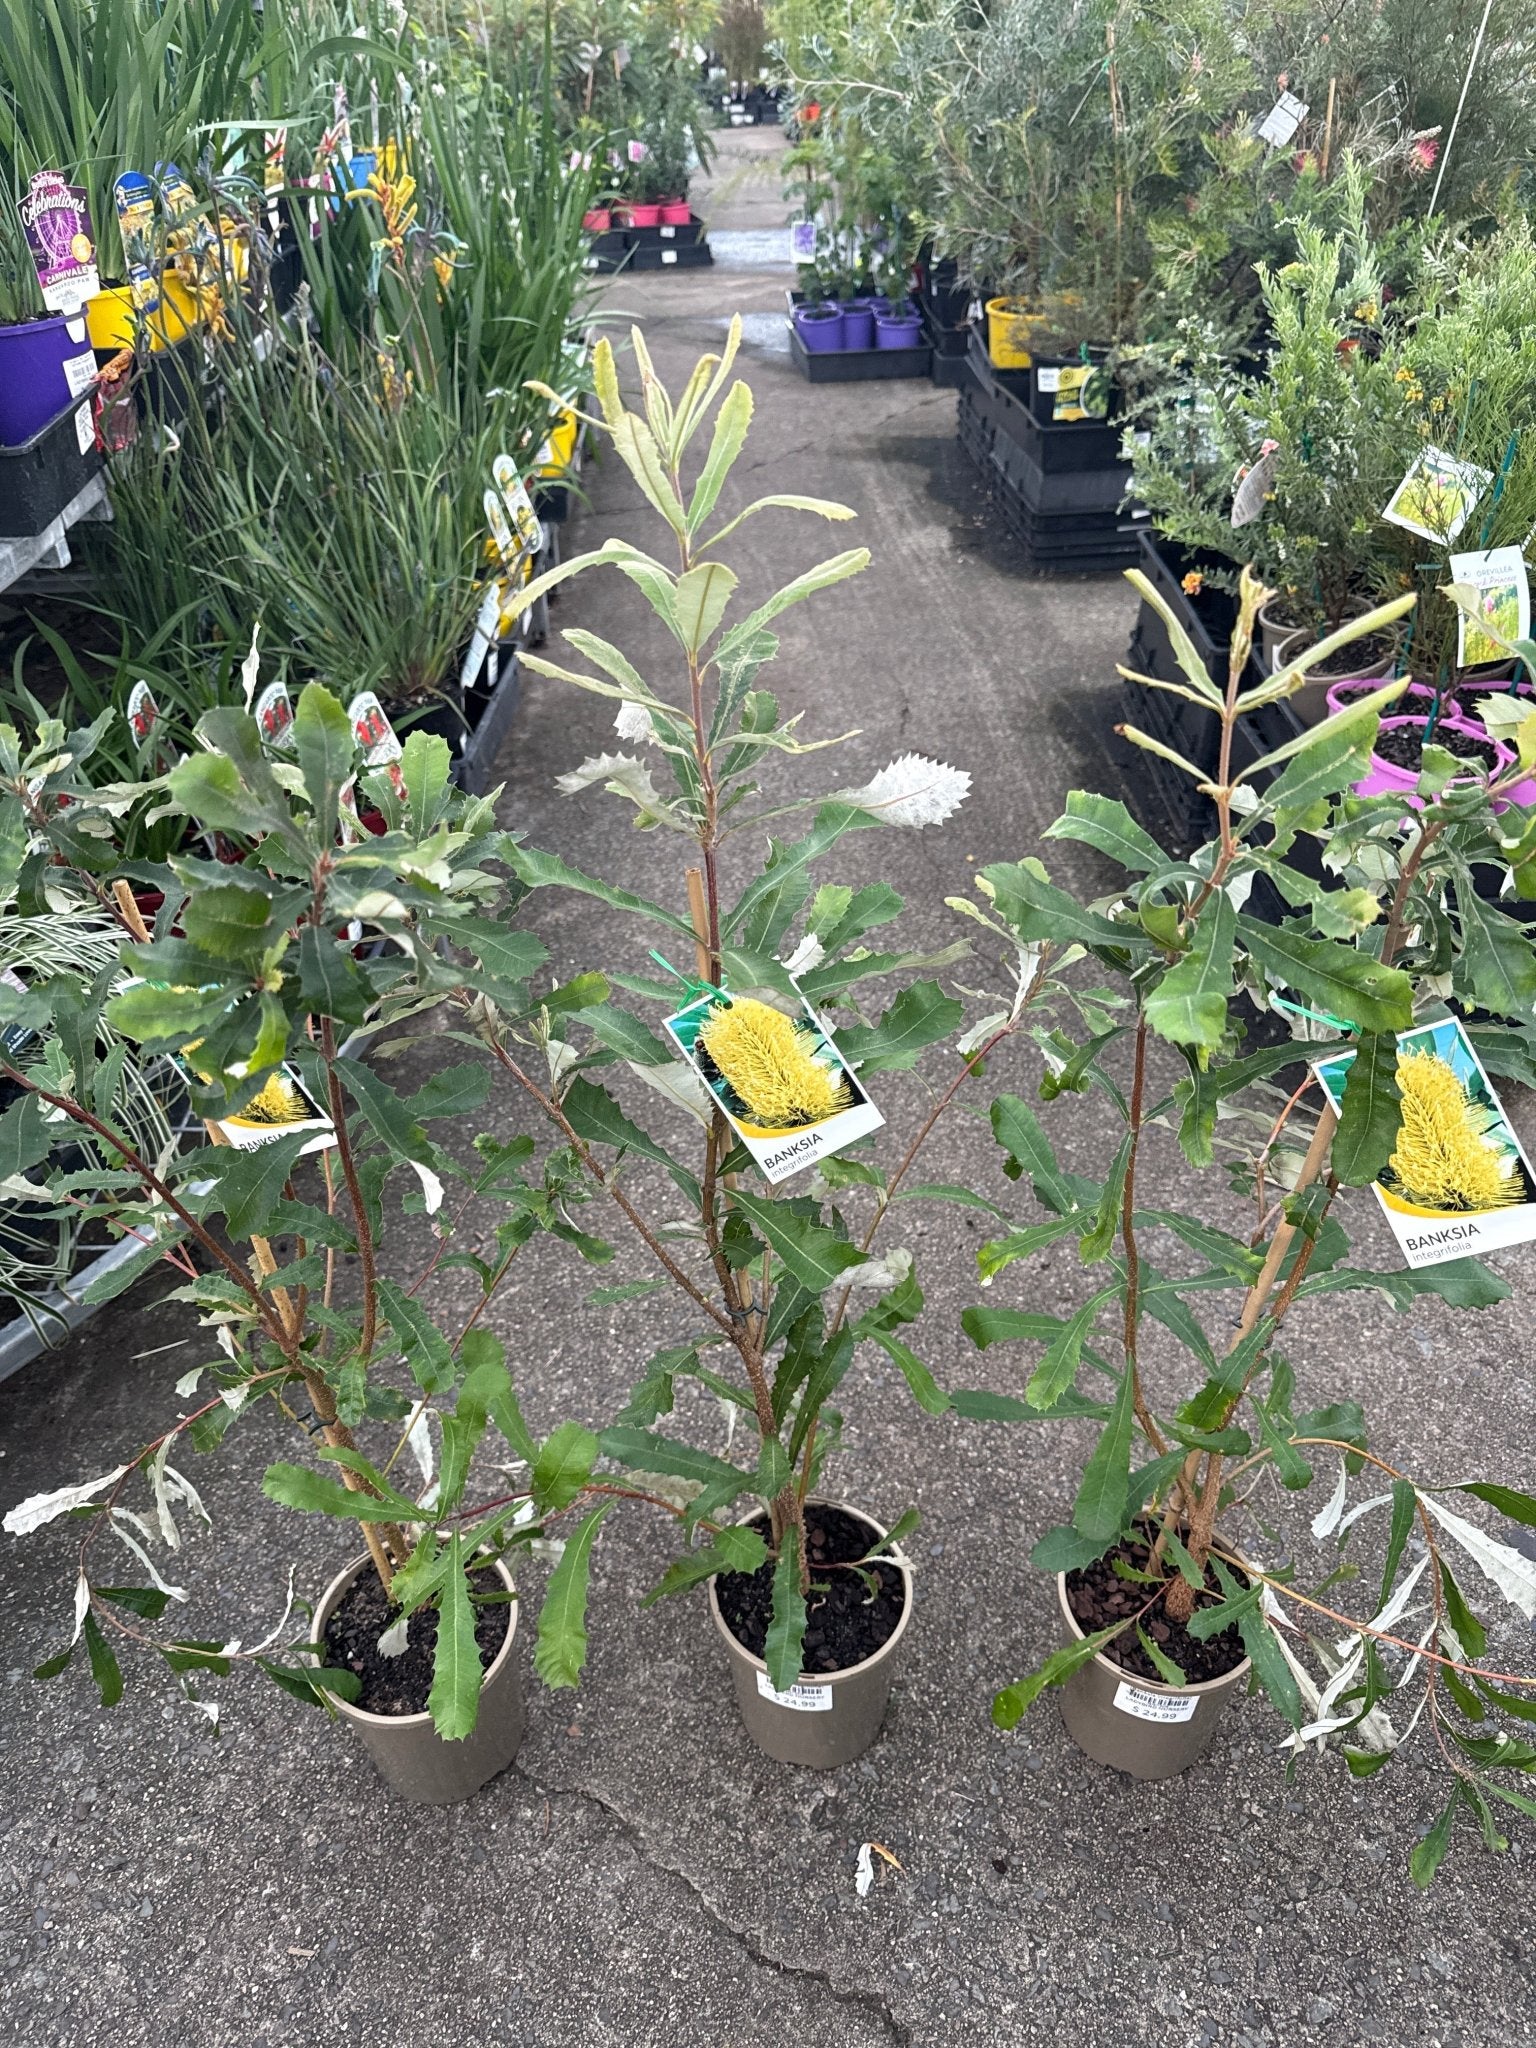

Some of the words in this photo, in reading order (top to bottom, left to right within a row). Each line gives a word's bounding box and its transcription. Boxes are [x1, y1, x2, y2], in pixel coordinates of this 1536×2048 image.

[22, 191, 86, 227] Celebrations
[47, 265, 89, 285] CARNIVALE
[764, 1133, 823, 1169] BANKSIA
[771, 1149, 818, 1177] integrifolia
[1405, 1223, 1481, 1251] BANKSIA
[1412, 1242, 1472, 1262] integrifolia
[783, 1697, 816, 1707] 24.99
[1142, 1709, 1177, 1719] 24.99
